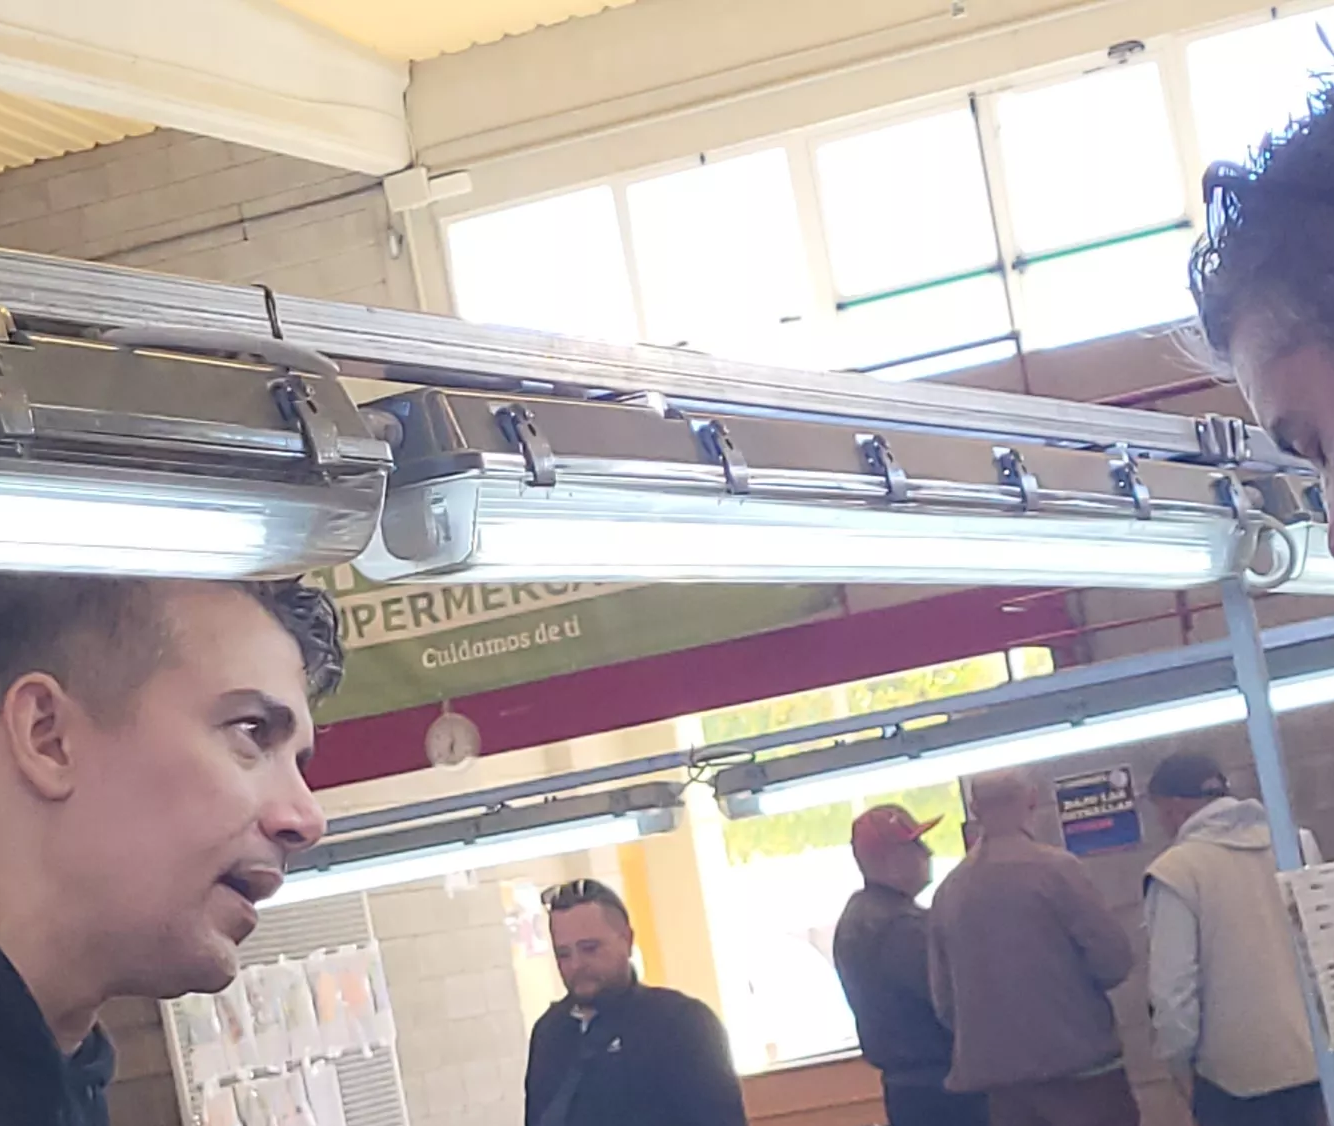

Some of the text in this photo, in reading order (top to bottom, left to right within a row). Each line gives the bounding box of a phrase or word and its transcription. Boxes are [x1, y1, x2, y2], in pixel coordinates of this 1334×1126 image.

[422, 614, 582, 668] Cuidamos de ti
